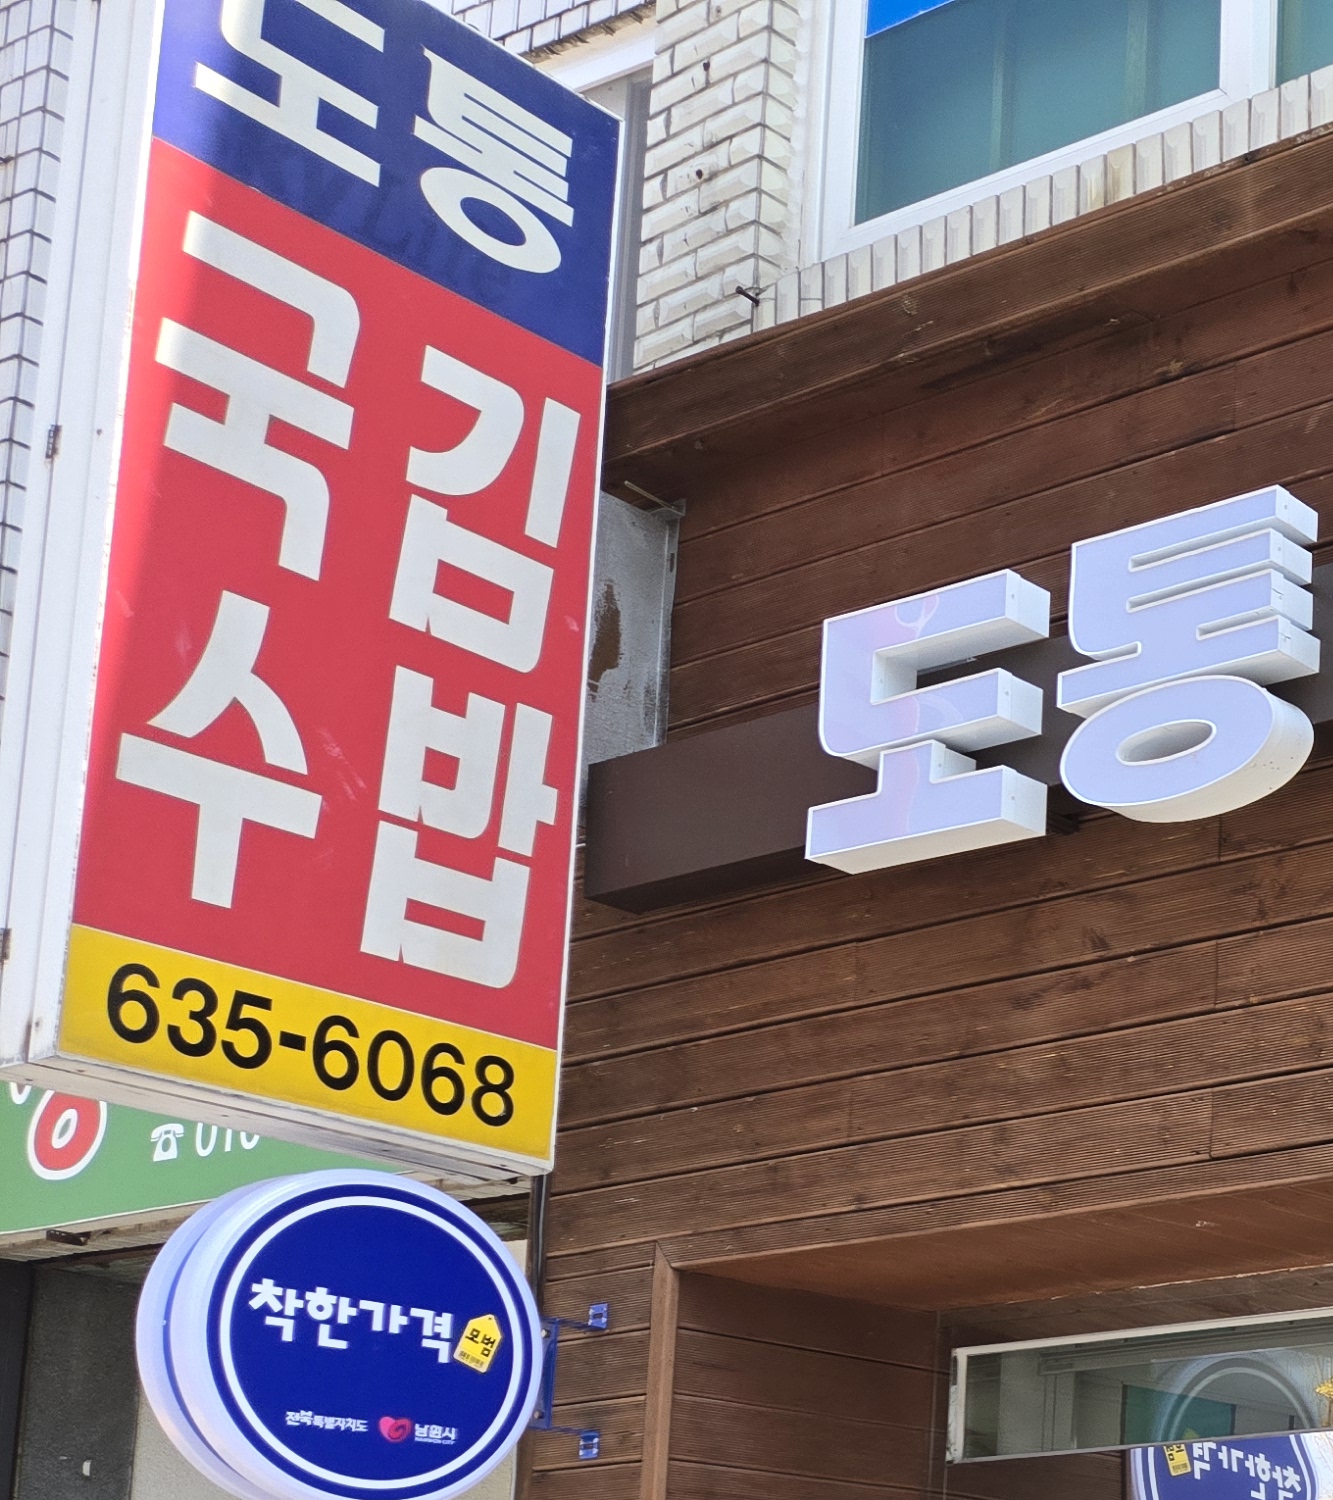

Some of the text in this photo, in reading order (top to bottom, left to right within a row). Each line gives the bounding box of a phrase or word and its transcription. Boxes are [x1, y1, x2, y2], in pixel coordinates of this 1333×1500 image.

[195, 0, 575, 274] 도통
[105, 962, 516, 1128] 635-6068
[248, 1277, 454, 1364] 착한가격
